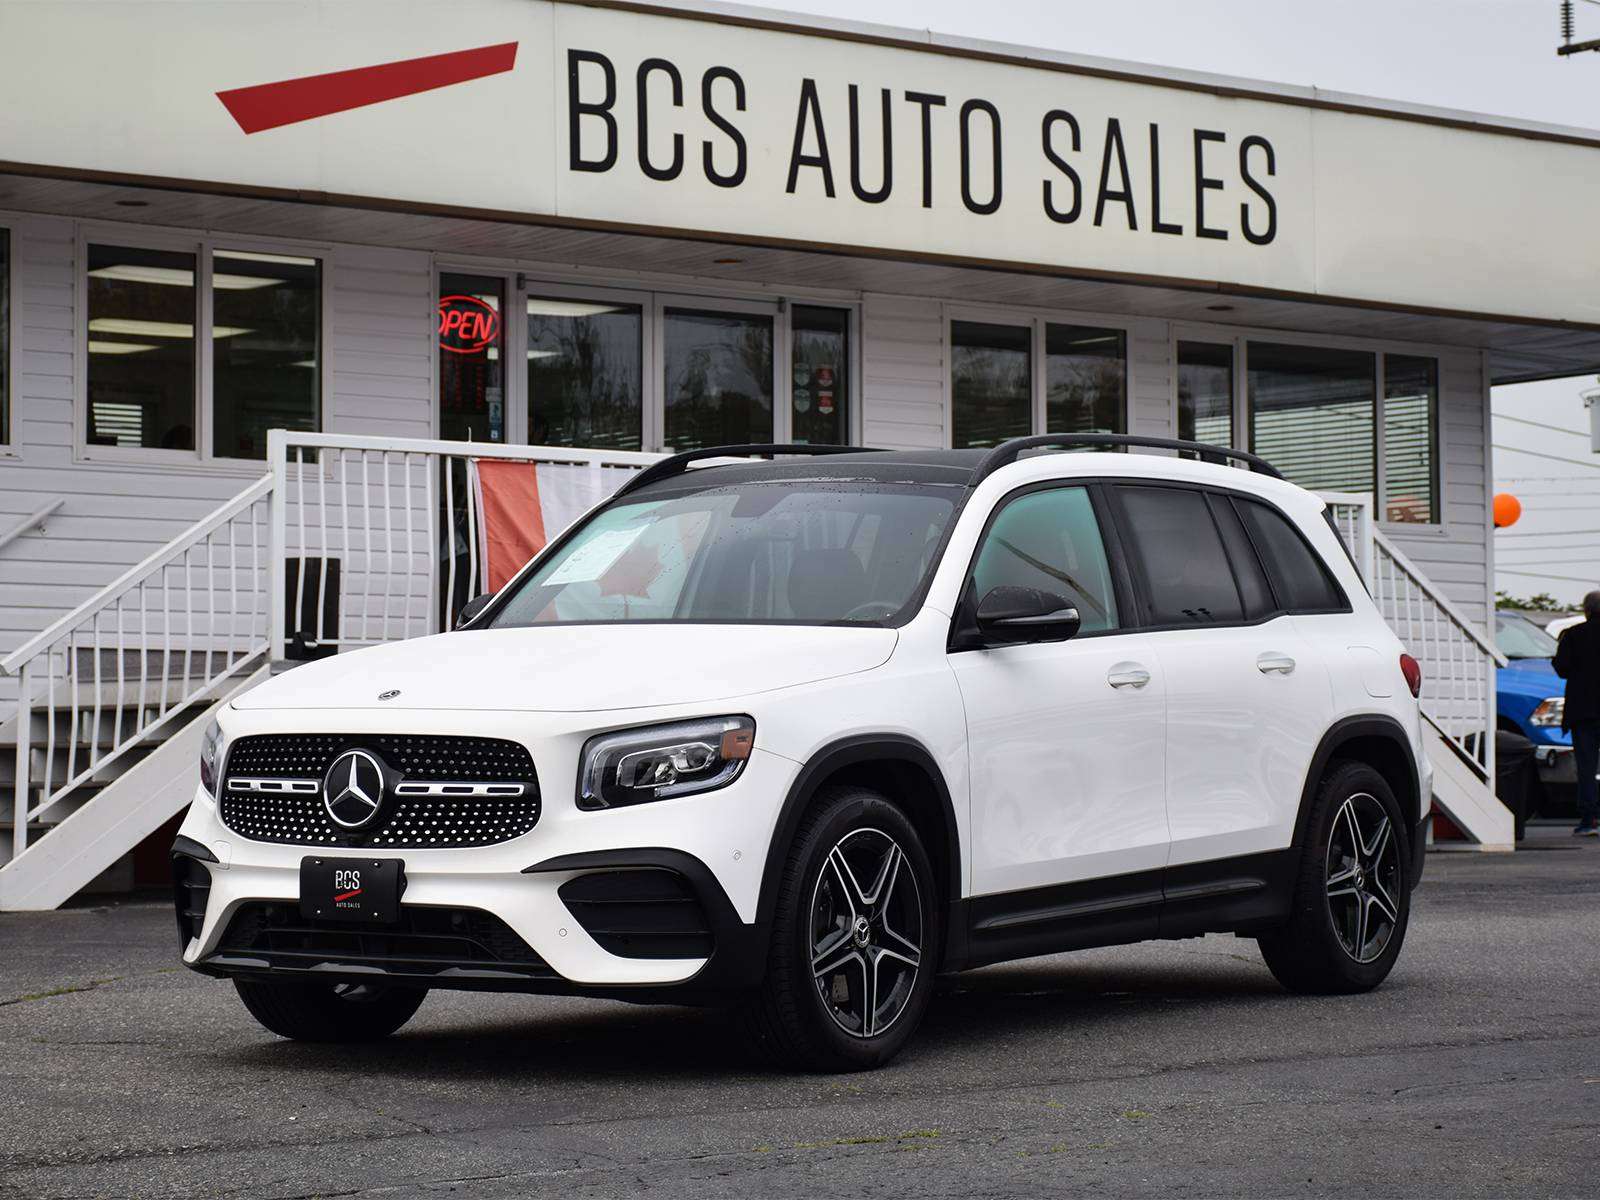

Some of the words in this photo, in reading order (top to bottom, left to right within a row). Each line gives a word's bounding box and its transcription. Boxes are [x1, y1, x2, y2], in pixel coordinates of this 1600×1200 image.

[568, 49, 747, 188] BCS
[785, 78, 1003, 216] AUTO
[1042, 109, 1277, 246] SALES
[335, 870, 360, 889] BCS
